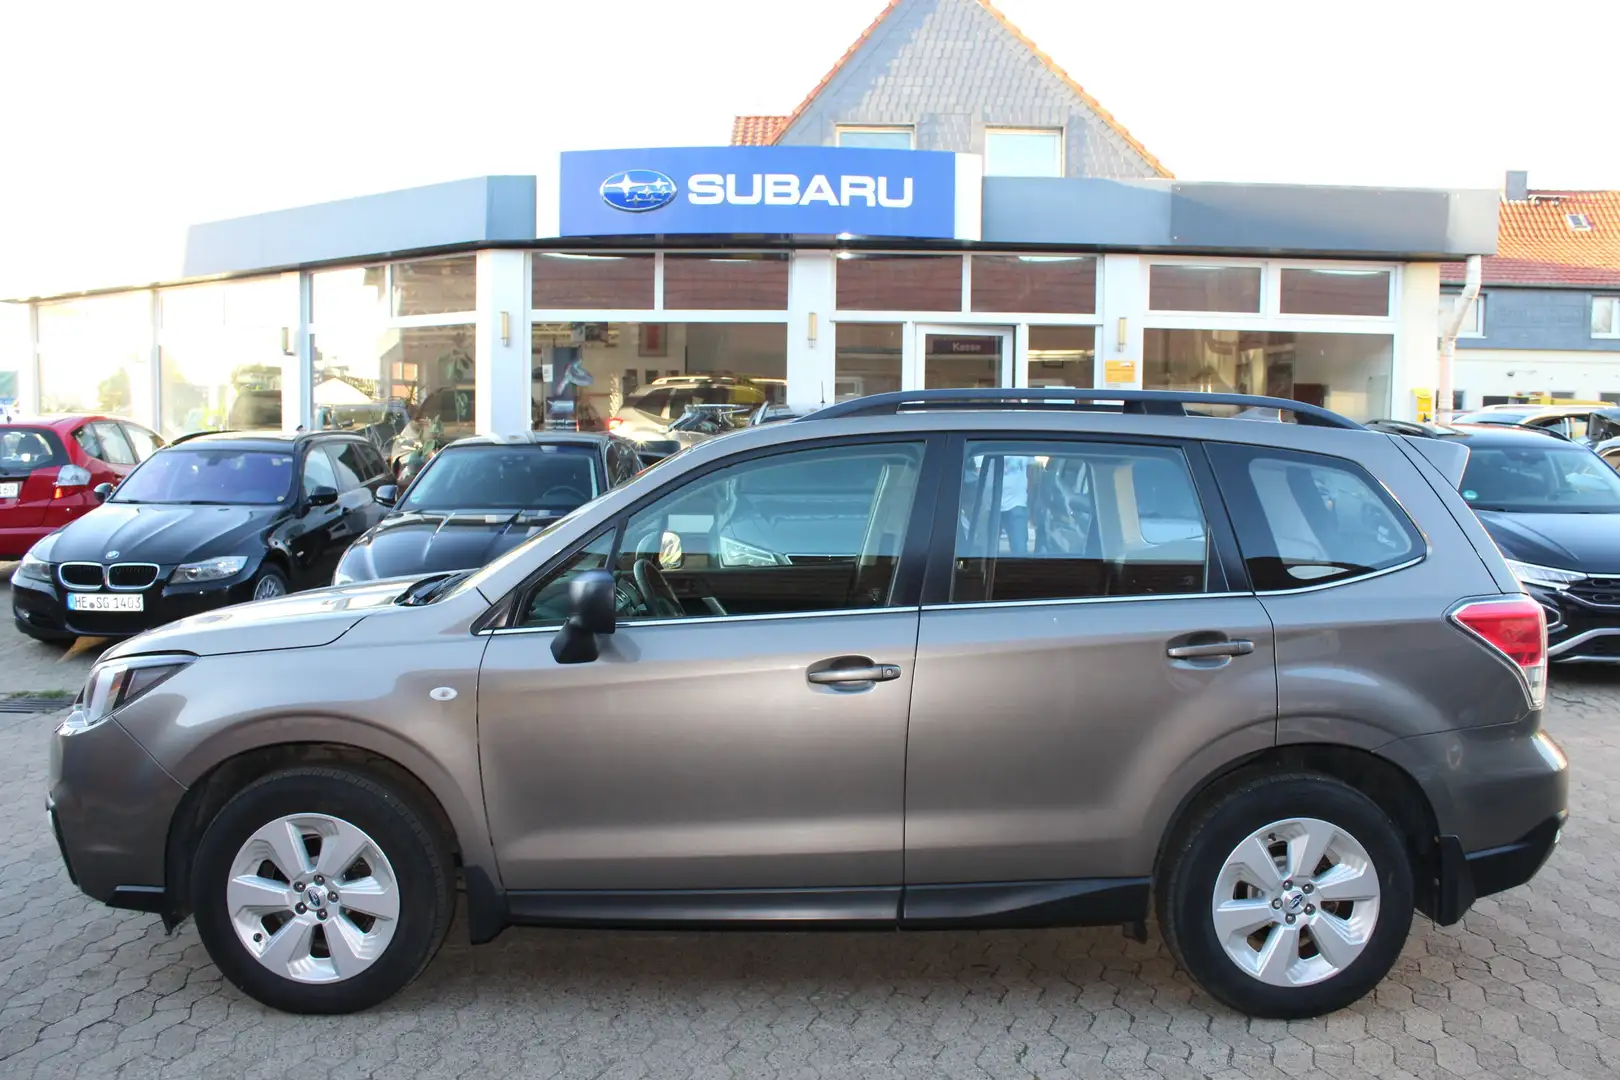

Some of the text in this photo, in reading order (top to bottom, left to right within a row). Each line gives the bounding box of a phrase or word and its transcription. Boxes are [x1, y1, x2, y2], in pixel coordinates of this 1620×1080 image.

[688, 173, 913, 208] SUBARU
[952, 341, 982, 352] Kasse
[75, 596, 141, 609] HE SG 1403
